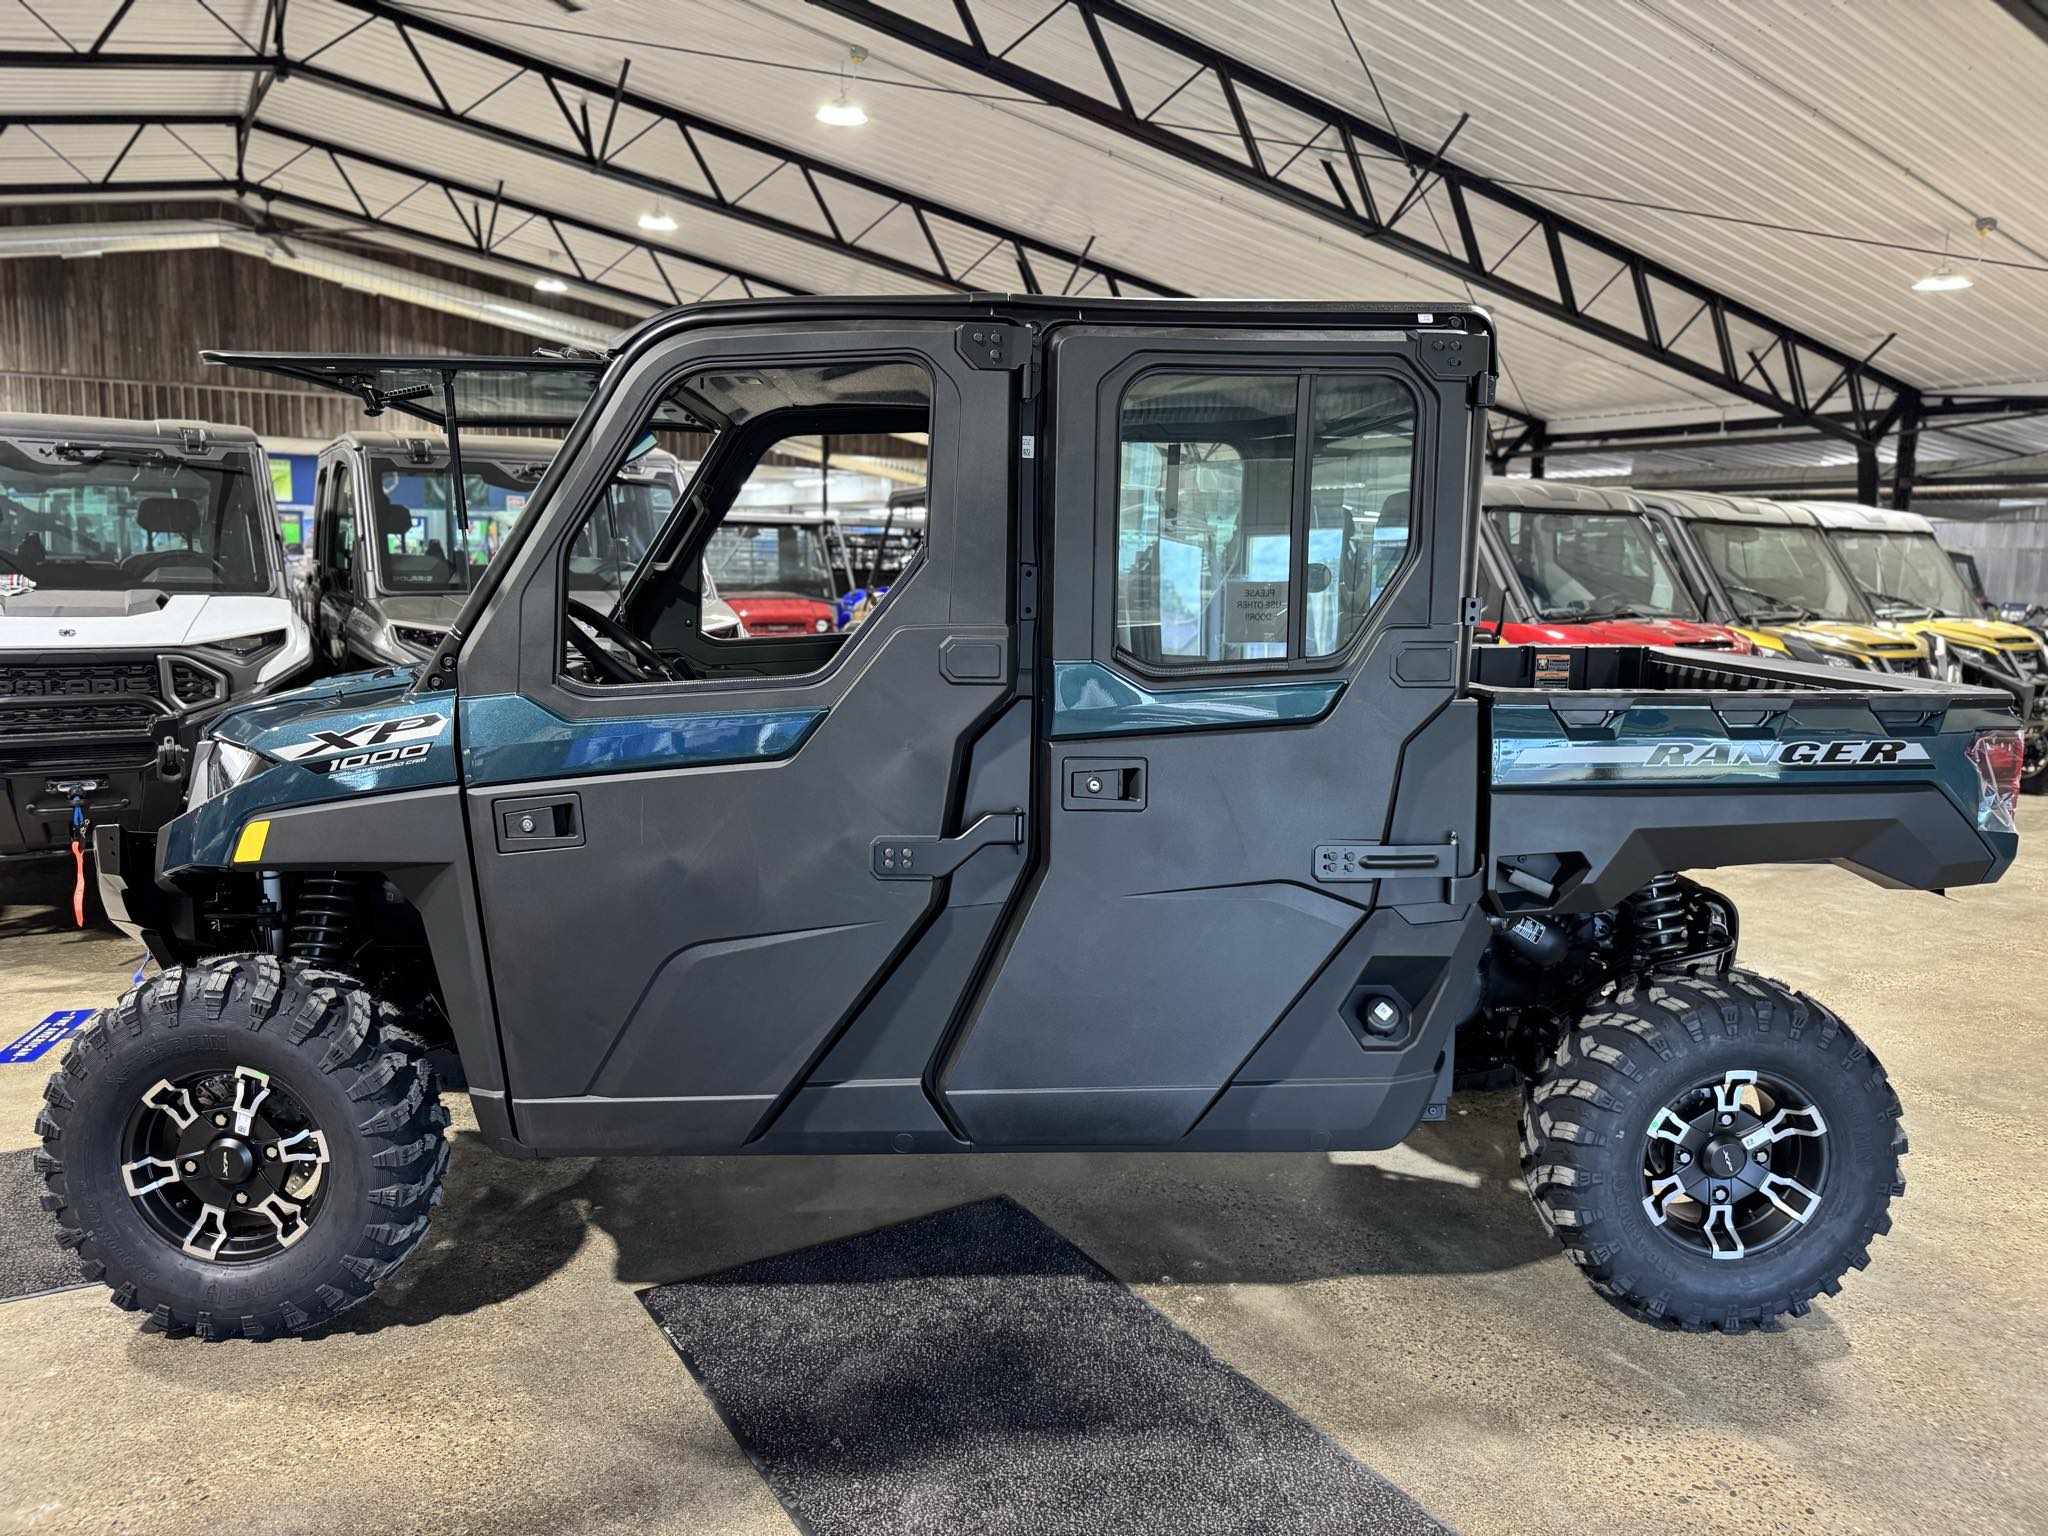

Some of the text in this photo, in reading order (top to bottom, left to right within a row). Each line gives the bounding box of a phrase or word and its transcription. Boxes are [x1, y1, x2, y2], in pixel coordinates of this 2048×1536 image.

[296, 713, 445, 759] XP
[328, 743, 432, 773] 1000
[405, 757, 428, 765] CAM
[1643, 740, 1908, 767] RANGER
